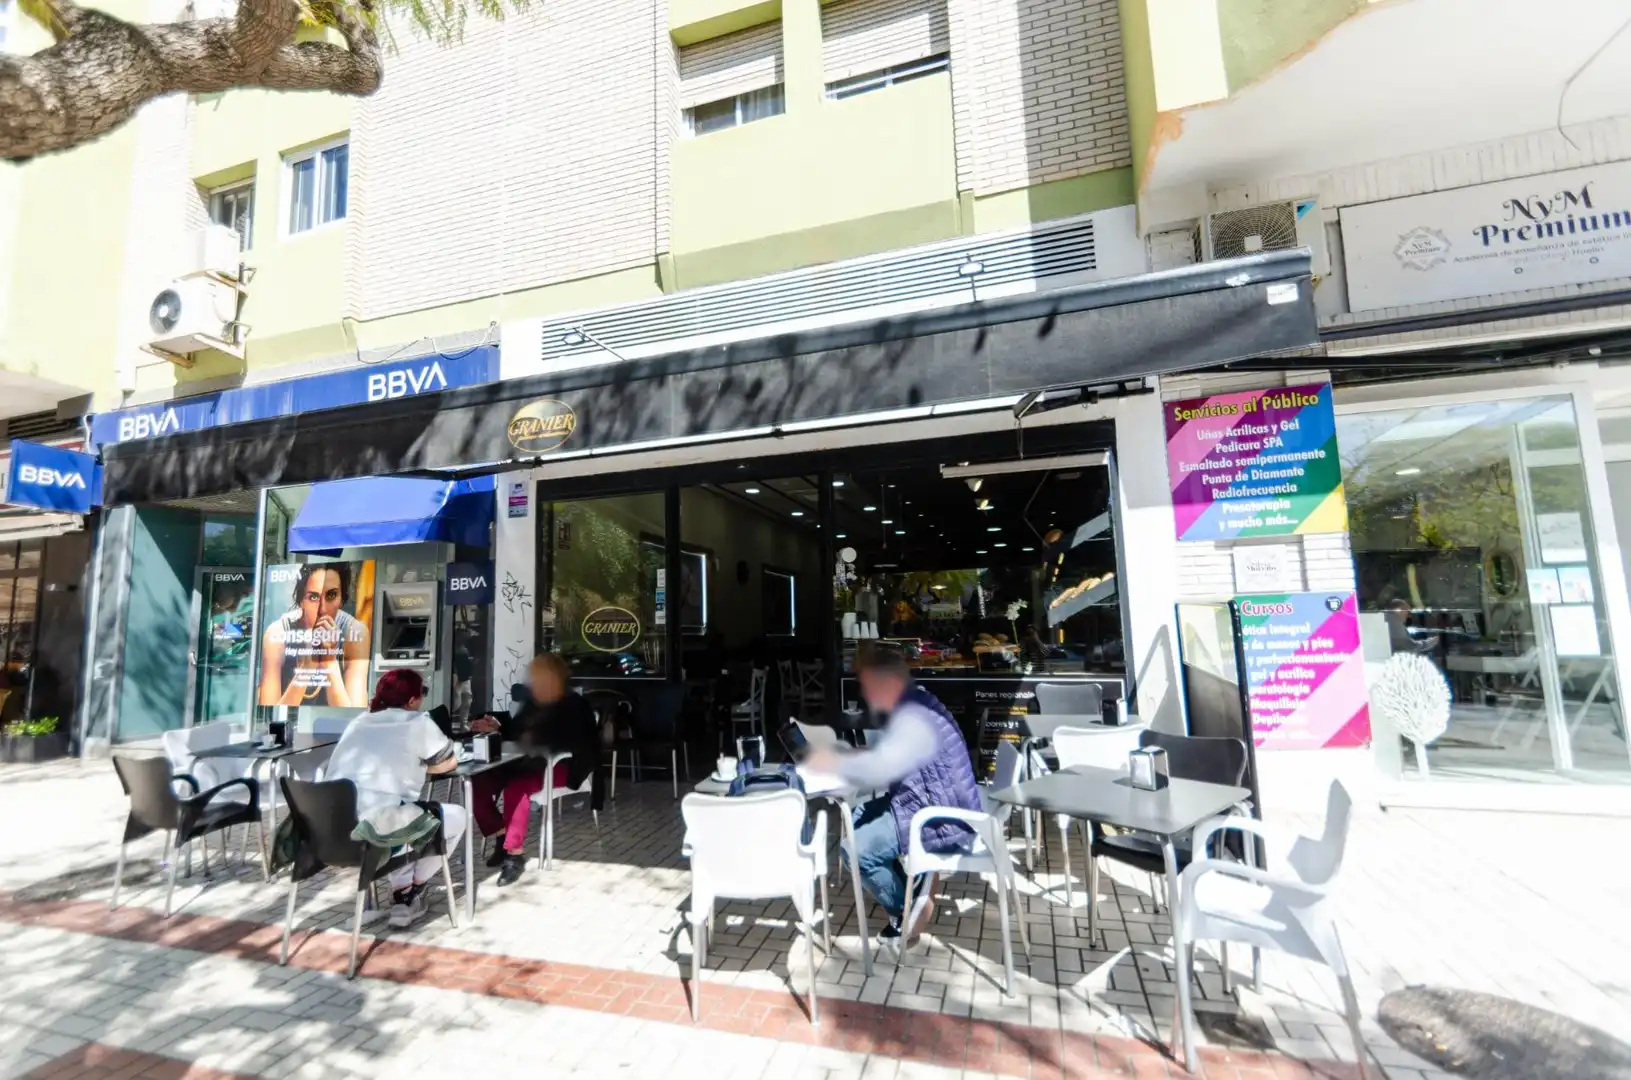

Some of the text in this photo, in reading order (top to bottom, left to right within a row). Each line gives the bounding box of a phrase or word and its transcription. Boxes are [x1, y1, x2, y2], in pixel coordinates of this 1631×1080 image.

[1503, 182, 1594, 222] NyM
[1473, 210, 1631, 247] Premium
[368, 361, 447, 402] BBVA
[1174, 391, 1320, 421] Servicios al Público
[119, 406, 180, 442] BBVA
[509, 414, 574, 438] GRANIER
[1196, 418, 1300, 441] Uñas Acrílicas y Gel
[1215, 435, 1283, 453] Pedicura SPA
[1179, 448, 1327, 473] Esmaltado semipermanente
[19, 464, 86, 489] BBVA
[1202, 466, 1305, 485] Punta de Diamante
[1212, 482, 1298, 500] Radiofrecuencia
[1222, 499, 1292, 514] Presoterapia
[1218, 521, 1226, 532] y
[1228, 516, 1264, 529] mucho
[214, 572, 246, 583] BBVA
[270, 567, 302, 583] BBVA
[450, 576, 488, 591] BBVA
[399, 596, 425, 607] BBVA
[1241, 600, 1294, 617] Cursos
[584, 621, 638, 637] GRANIER
[1311, 636, 1334, 650] pies
